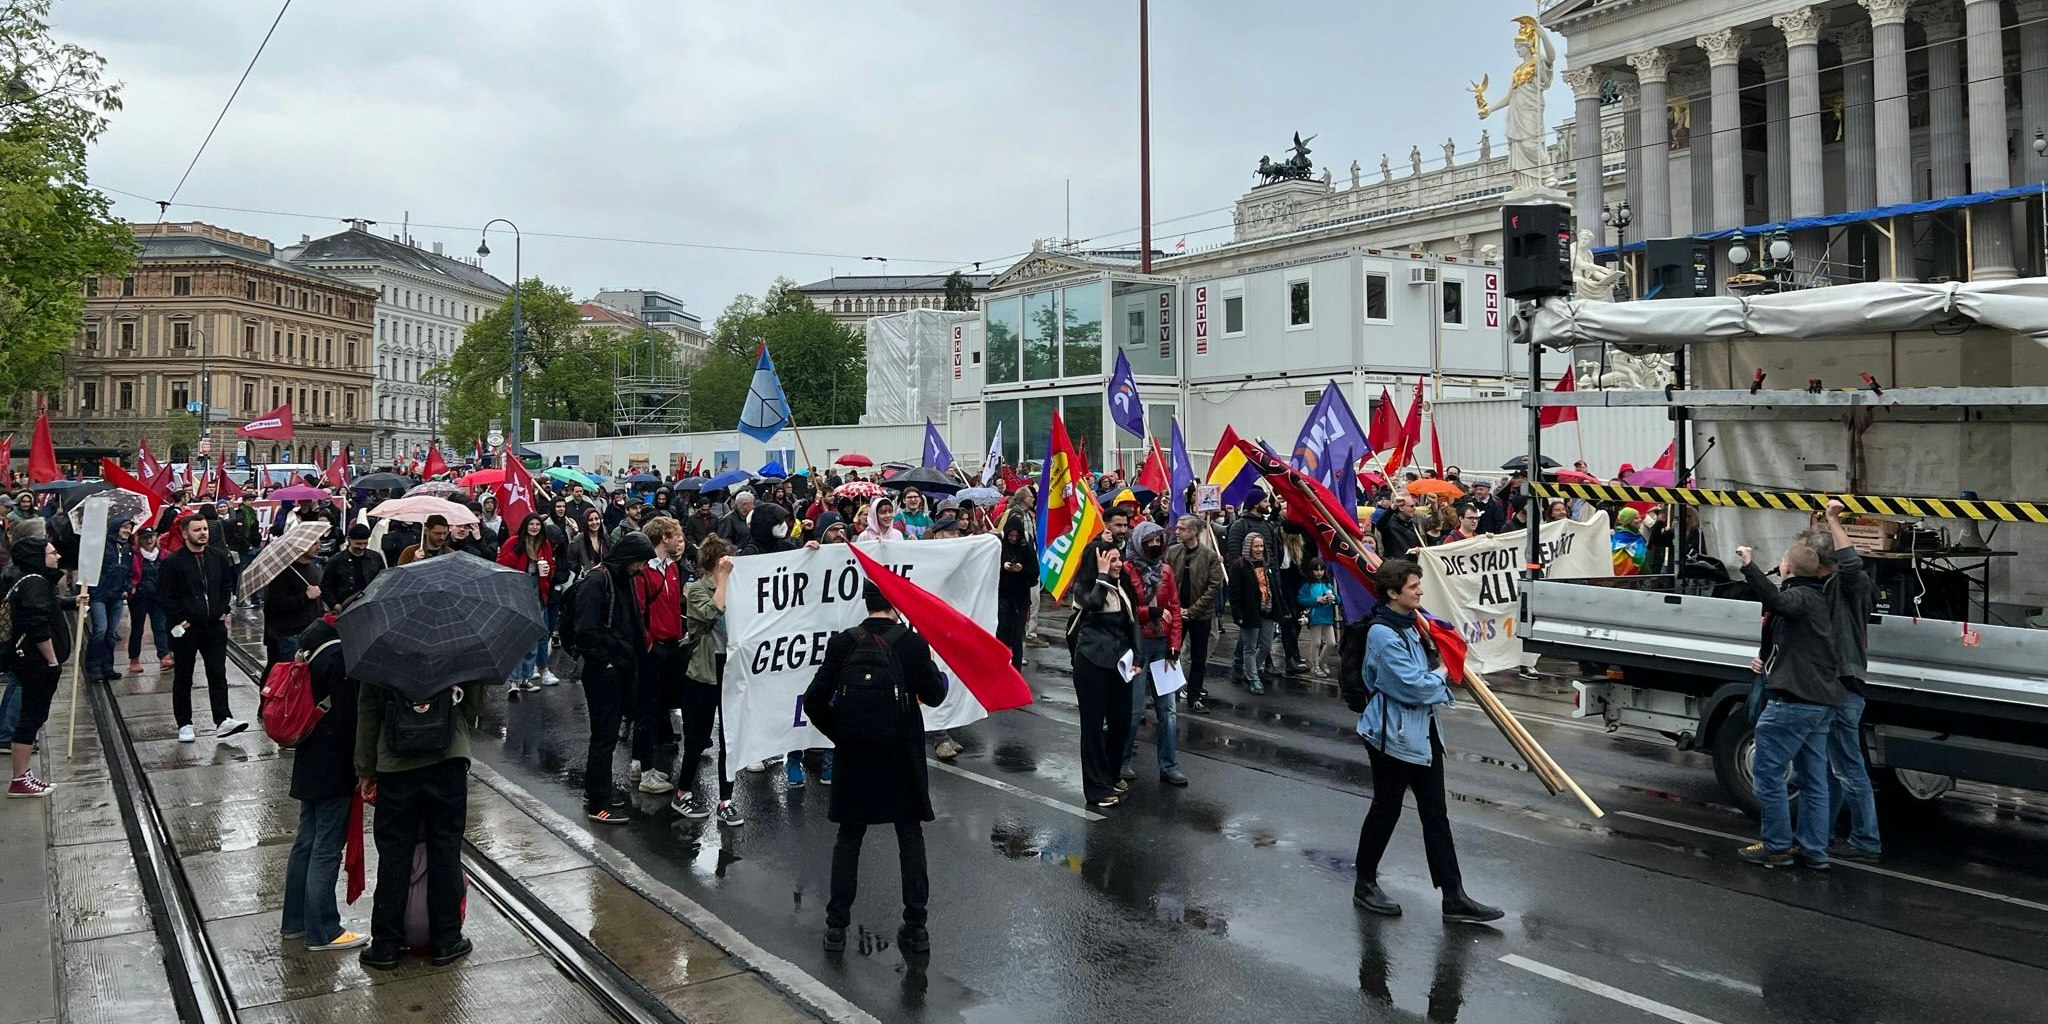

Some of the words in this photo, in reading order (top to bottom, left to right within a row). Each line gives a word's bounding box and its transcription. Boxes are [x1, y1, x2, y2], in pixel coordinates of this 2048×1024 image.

[1197, 288, 1206, 336] CHV
[1486, 274, 1497, 327] CHV
[1440, 554, 1468, 576] DIE
[1470, 546, 1519, 574] STADT
[757, 566, 809, 614] FÜR
[751, 630, 840, 675] GEGE
